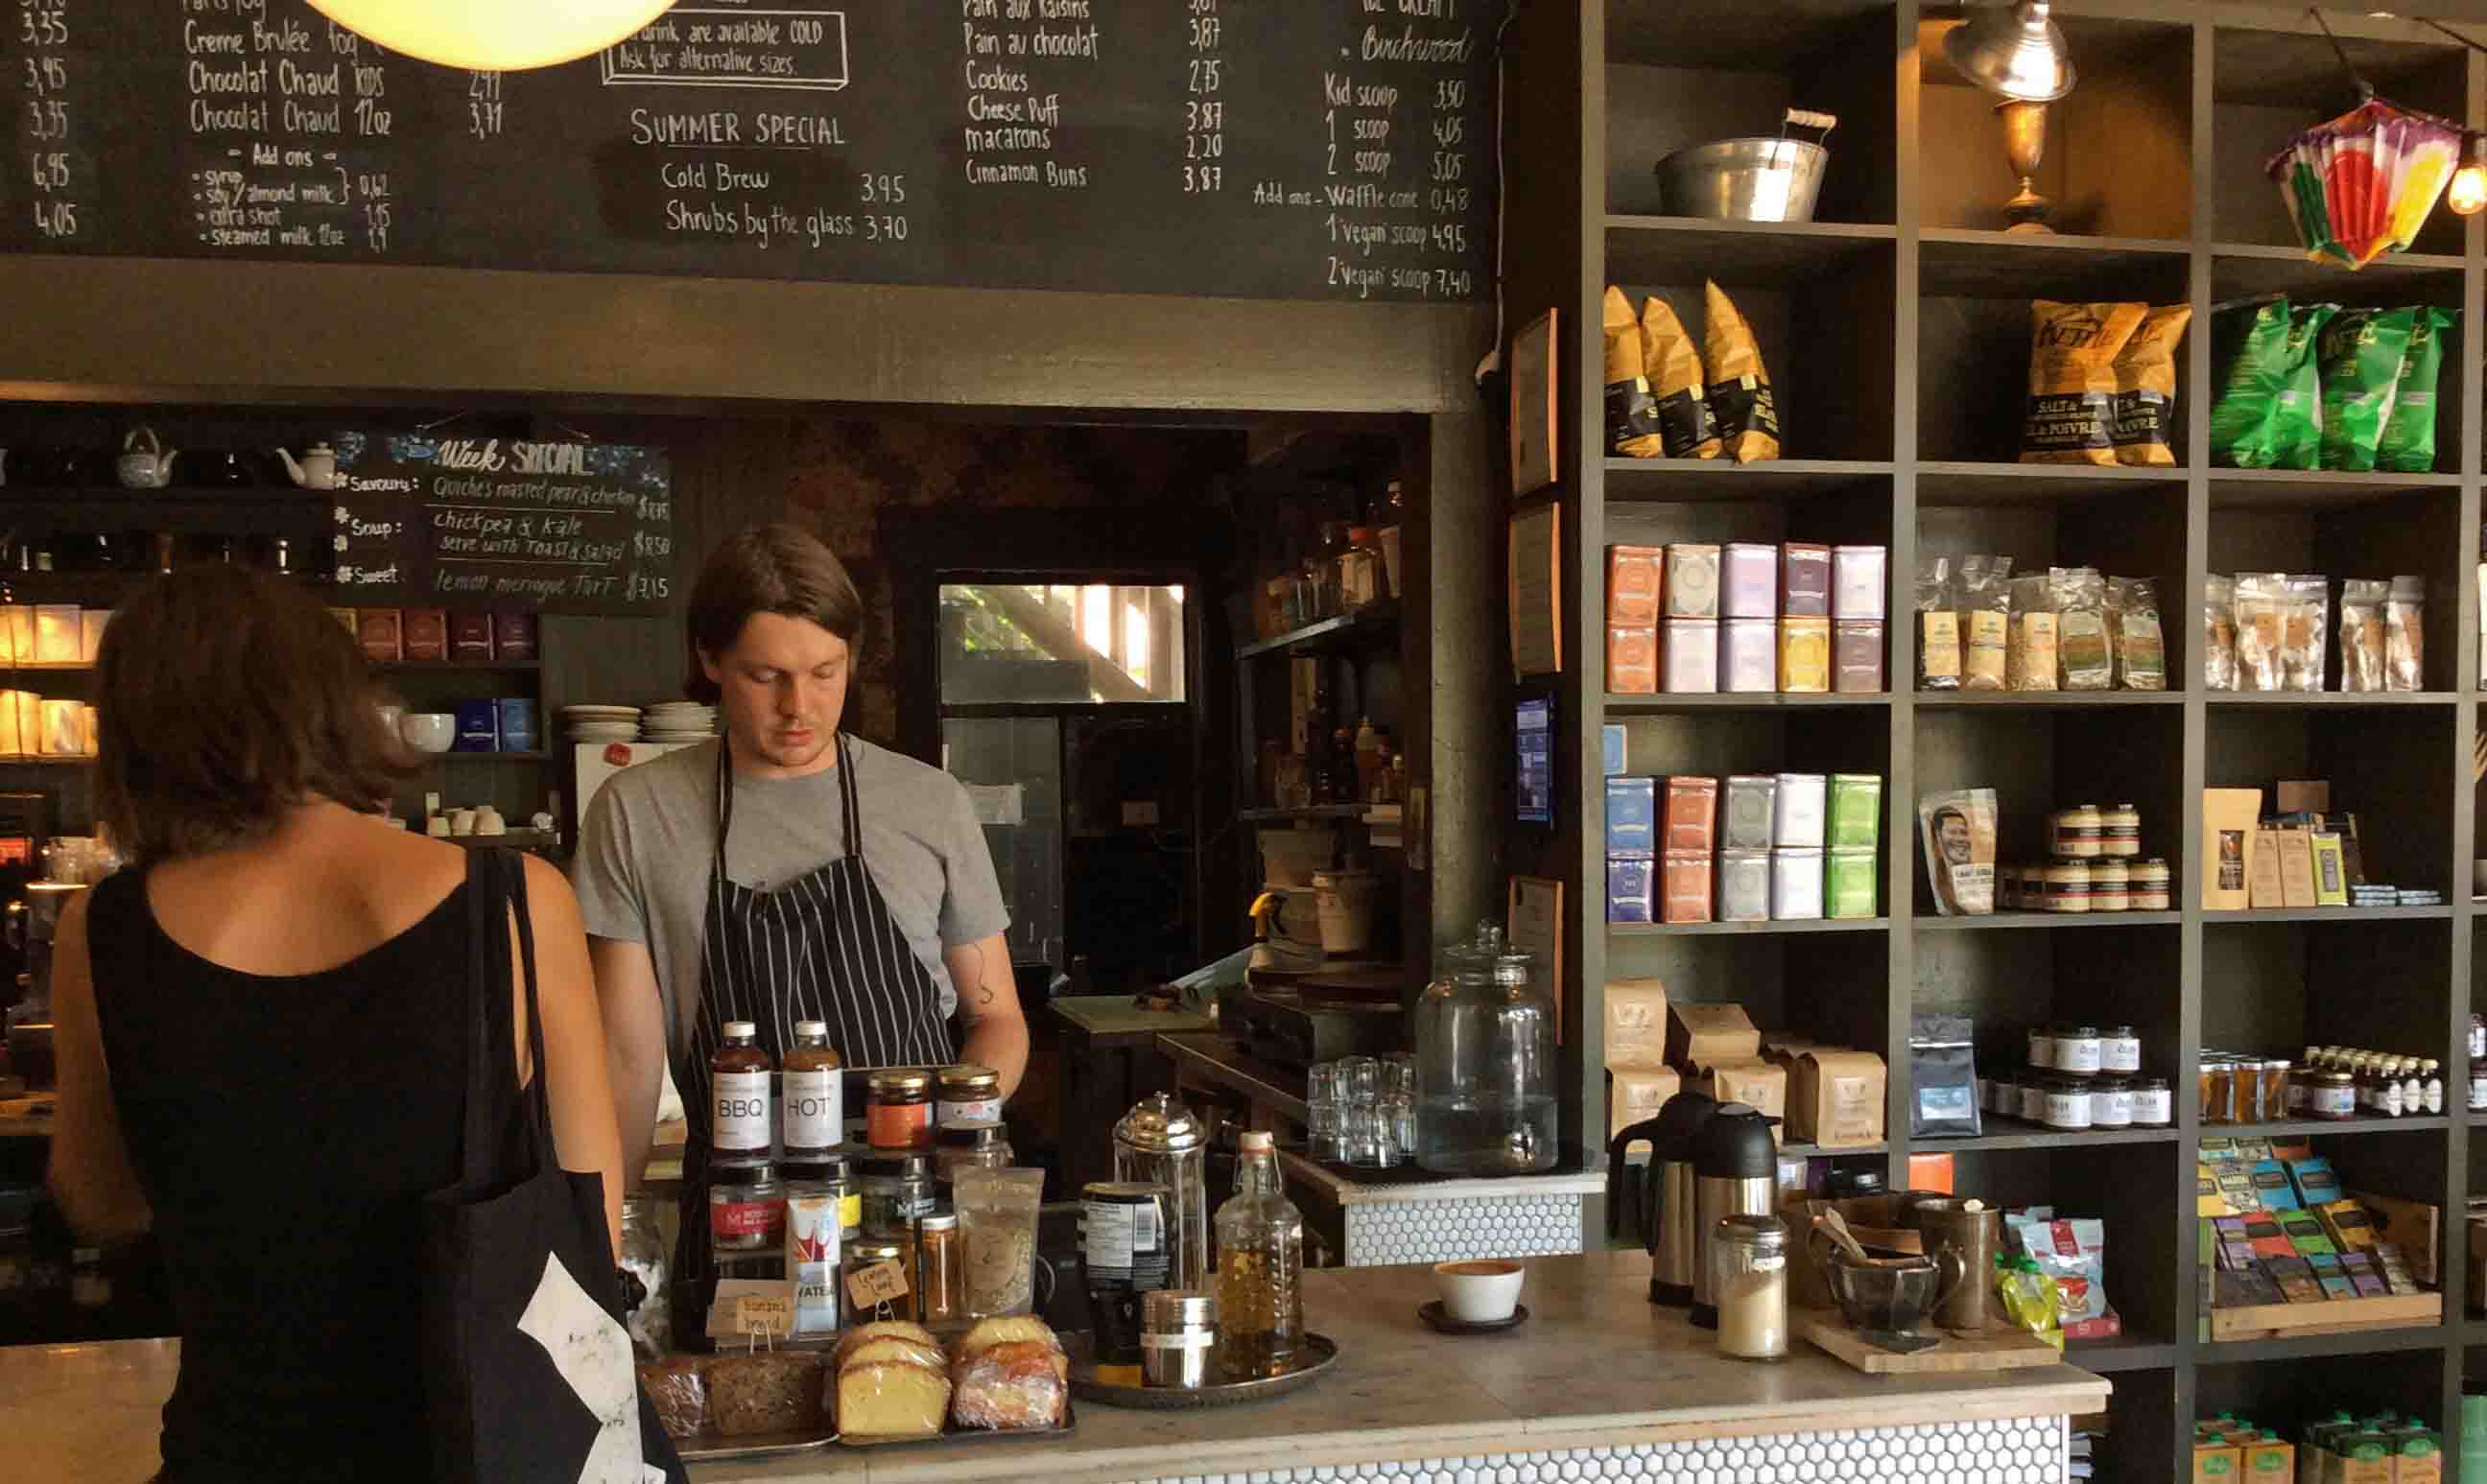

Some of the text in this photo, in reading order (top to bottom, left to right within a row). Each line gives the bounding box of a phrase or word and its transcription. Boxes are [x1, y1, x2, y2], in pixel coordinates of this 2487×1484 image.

[687, 22, 713, 43] are
[789, 19, 823, 45] COLD
[963, 22, 1001, 55] Pain
[1033, 24, 1099, 59] chocolat
[679, 46, 753, 72] alternative
[965, 59, 1030, 93] Cookies
[189, 59, 269, 94] Chocolat
[278, 58, 340, 95] Chaud
[191, 99, 270, 133] Chocolat
[283, 99, 341, 133] Chaud
[629, 107, 846, 145] SUMMER SPECIAL
[967, 94, 1060, 129] Cheese Puff
[252, 142, 278, 166] Add
[660, 161, 770, 192] Cold Brew
[965, 159, 1088, 187] Cinnamon Buns
[666, 199, 740, 234] Shrubs
[745, 202, 769, 249] by
[806, 206, 854, 247] glass
[434, 438, 507, 472] Week
[718, 1097, 765, 1120] BBQ
[787, 1096, 832, 1119] HOT
